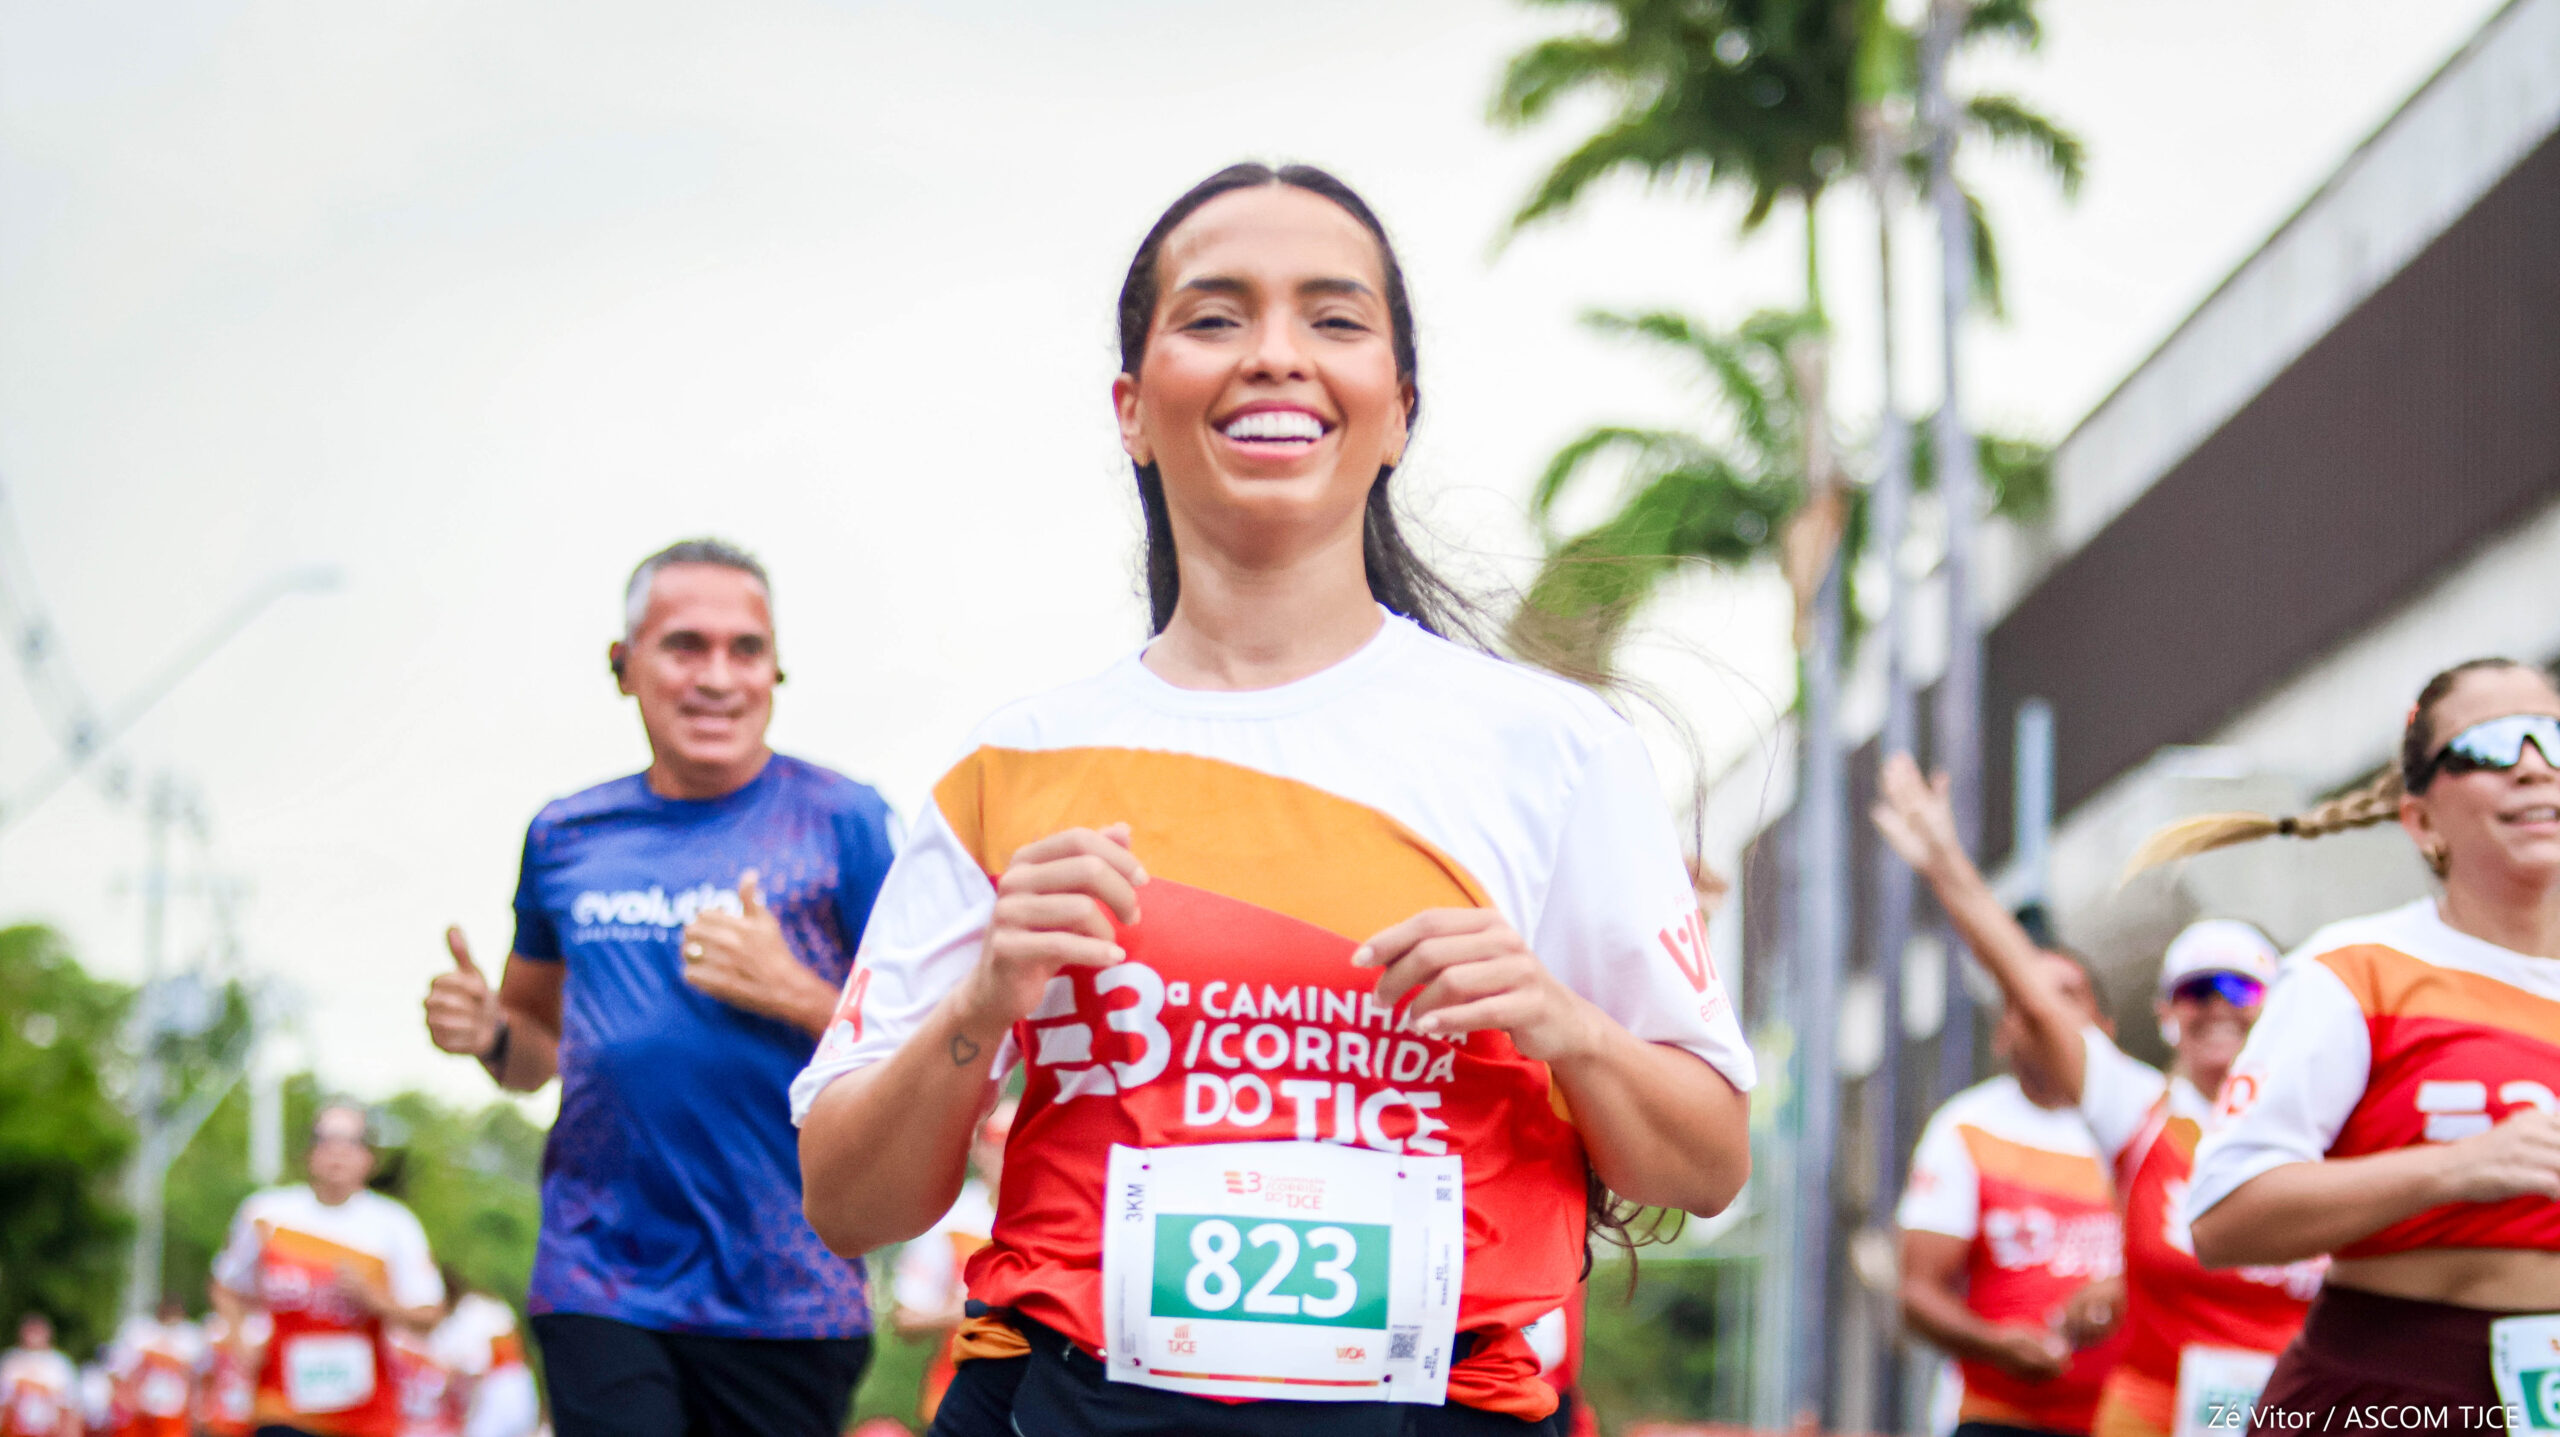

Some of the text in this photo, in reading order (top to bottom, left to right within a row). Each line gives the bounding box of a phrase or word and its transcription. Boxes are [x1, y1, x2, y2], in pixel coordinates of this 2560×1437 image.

[1185, 1073, 1449, 1154] DO TJCE
[1126, 1183, 1145, 1222] 3KM
[1286, 1194, 1321, 1209] TJCE
[1184, 1219, 1358, 1318] 823
[1168, 1339, 1197, 1354] TJCE
